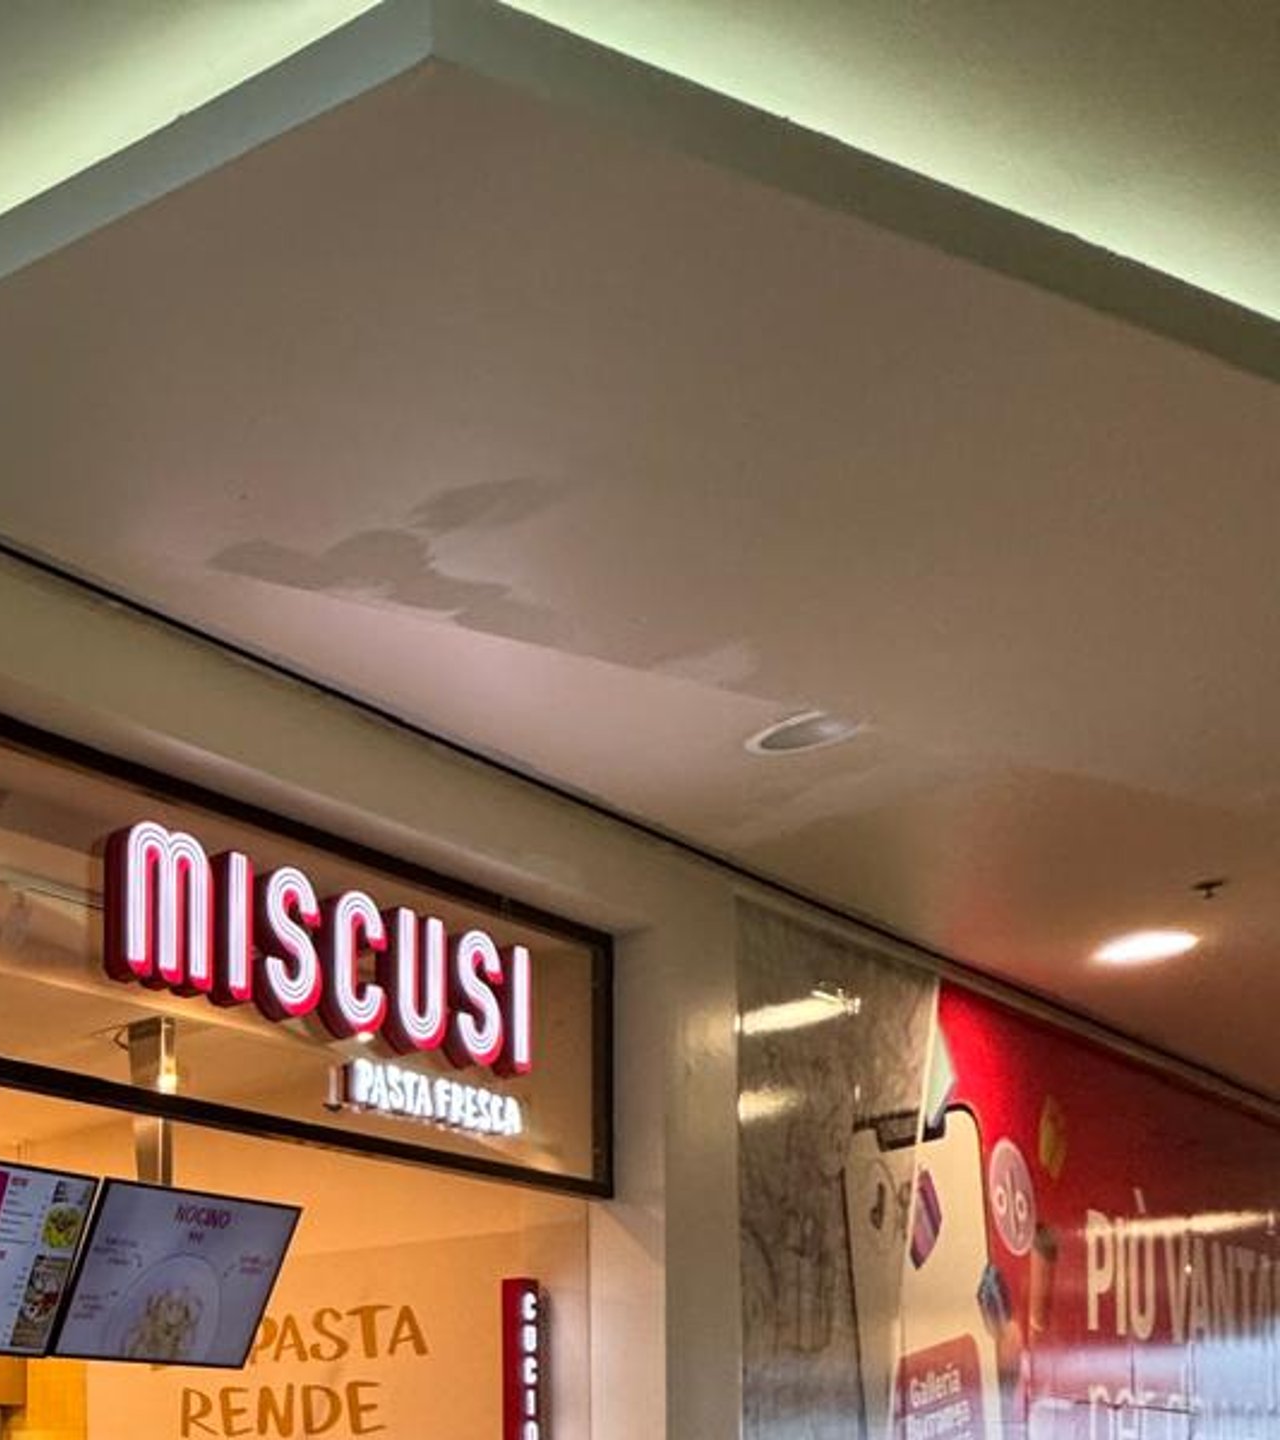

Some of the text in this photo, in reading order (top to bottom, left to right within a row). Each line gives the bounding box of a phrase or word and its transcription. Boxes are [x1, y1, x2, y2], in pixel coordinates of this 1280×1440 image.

[126, 820, 533, 1074] MISCUSI
[351, 1057, 523, 1136] PASTA FRESCA
[248, 1304, 429, 1365] PASTA
[180, 1380, 387, 1439] RENDE
